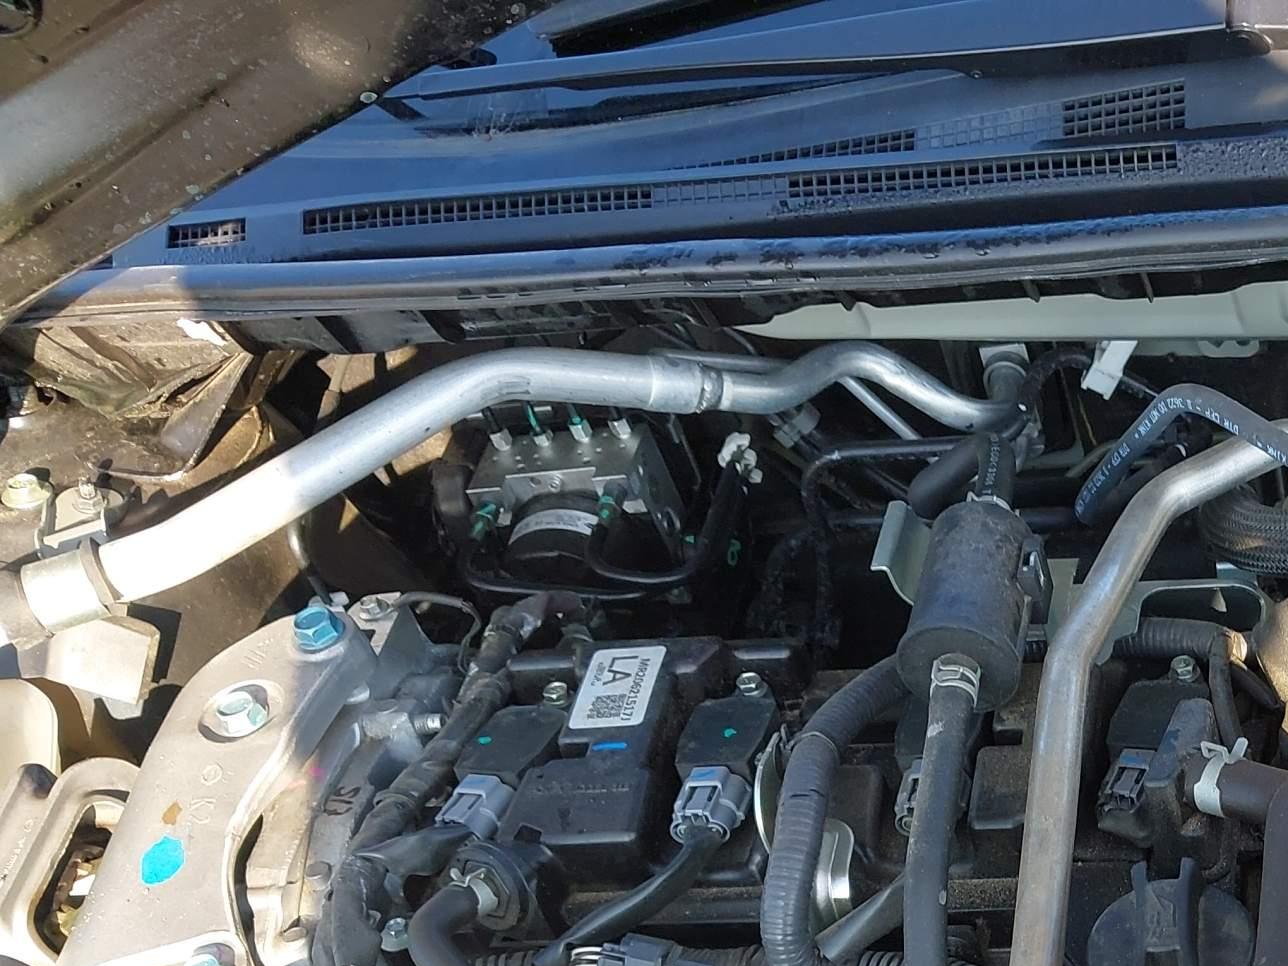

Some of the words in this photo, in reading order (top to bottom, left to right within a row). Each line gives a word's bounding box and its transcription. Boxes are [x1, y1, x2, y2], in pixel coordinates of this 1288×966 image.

[1222, 417, 1239, 436] DTR
[1267, 444, 1287, 463] KINK
[602, 655, 639, 686] LA
